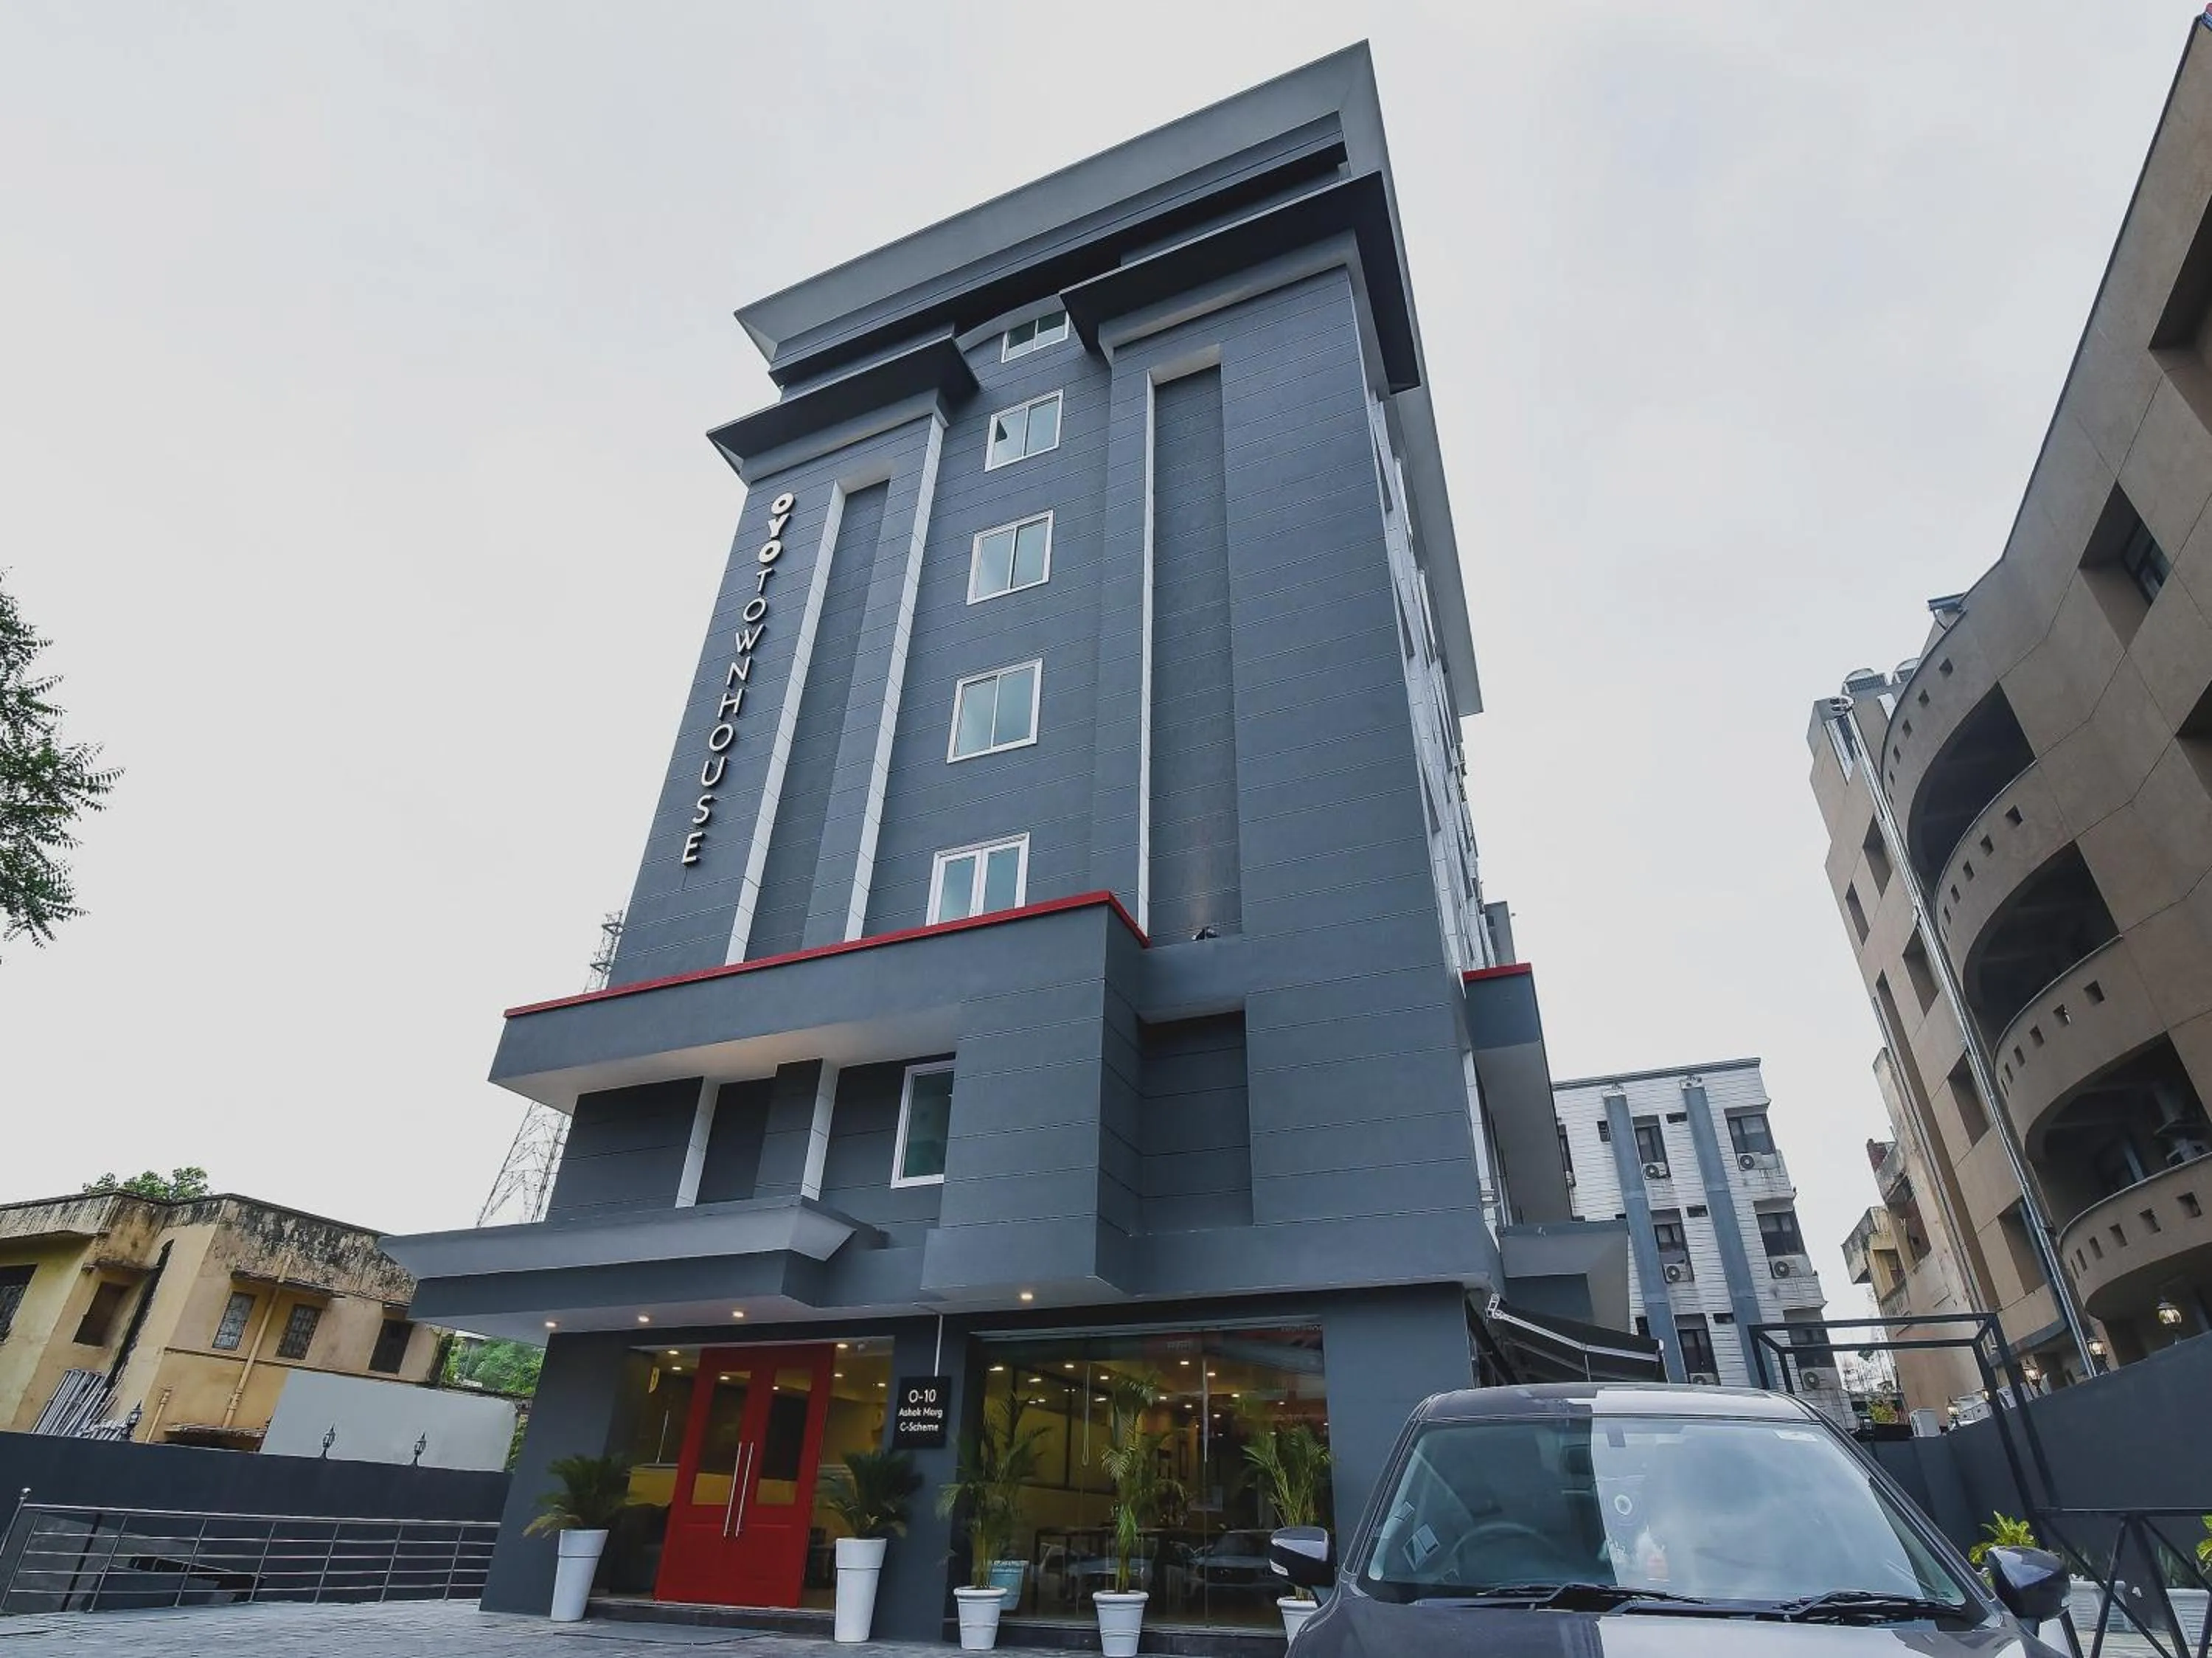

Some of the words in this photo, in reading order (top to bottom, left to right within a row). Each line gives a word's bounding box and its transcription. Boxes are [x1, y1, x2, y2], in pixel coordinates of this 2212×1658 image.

[758, 492, 795, 563] OYO
[681, 567, 773, 865] TOWNHOUSE
[898, 1406, 922, 1417] Ashok
[899, 1421, 939, 1432] C-Scheme
